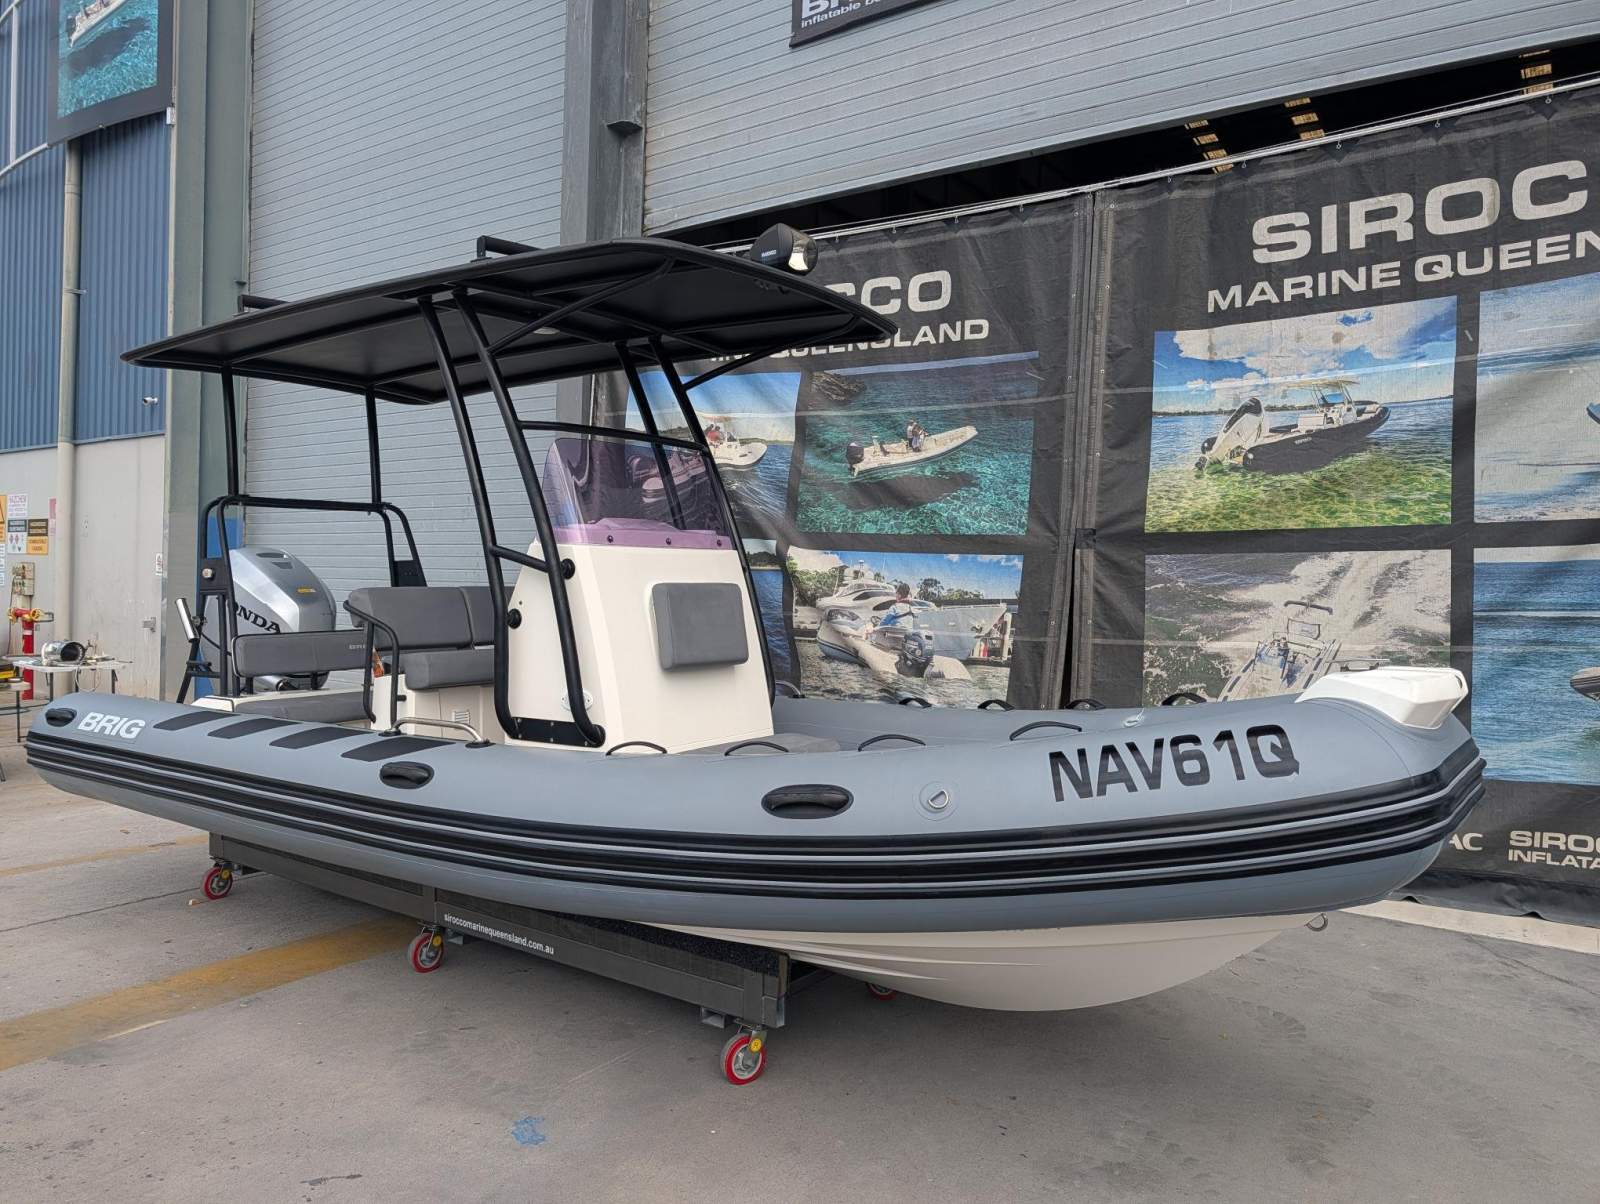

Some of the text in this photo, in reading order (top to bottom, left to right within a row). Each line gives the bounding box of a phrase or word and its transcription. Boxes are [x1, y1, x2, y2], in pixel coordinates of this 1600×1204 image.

[1251, 160, 1589, 264] SIROC
[1207, 230, 1600, 313] MARINE QUEEN
[77, 711, 146, 739] BRIG
[1049, 723, 1300, 803] NAV61Q
[1509, 830, 1600, 854] SIRO
[444, 913, 555, 955] siroccomarinequeensland.com.au
